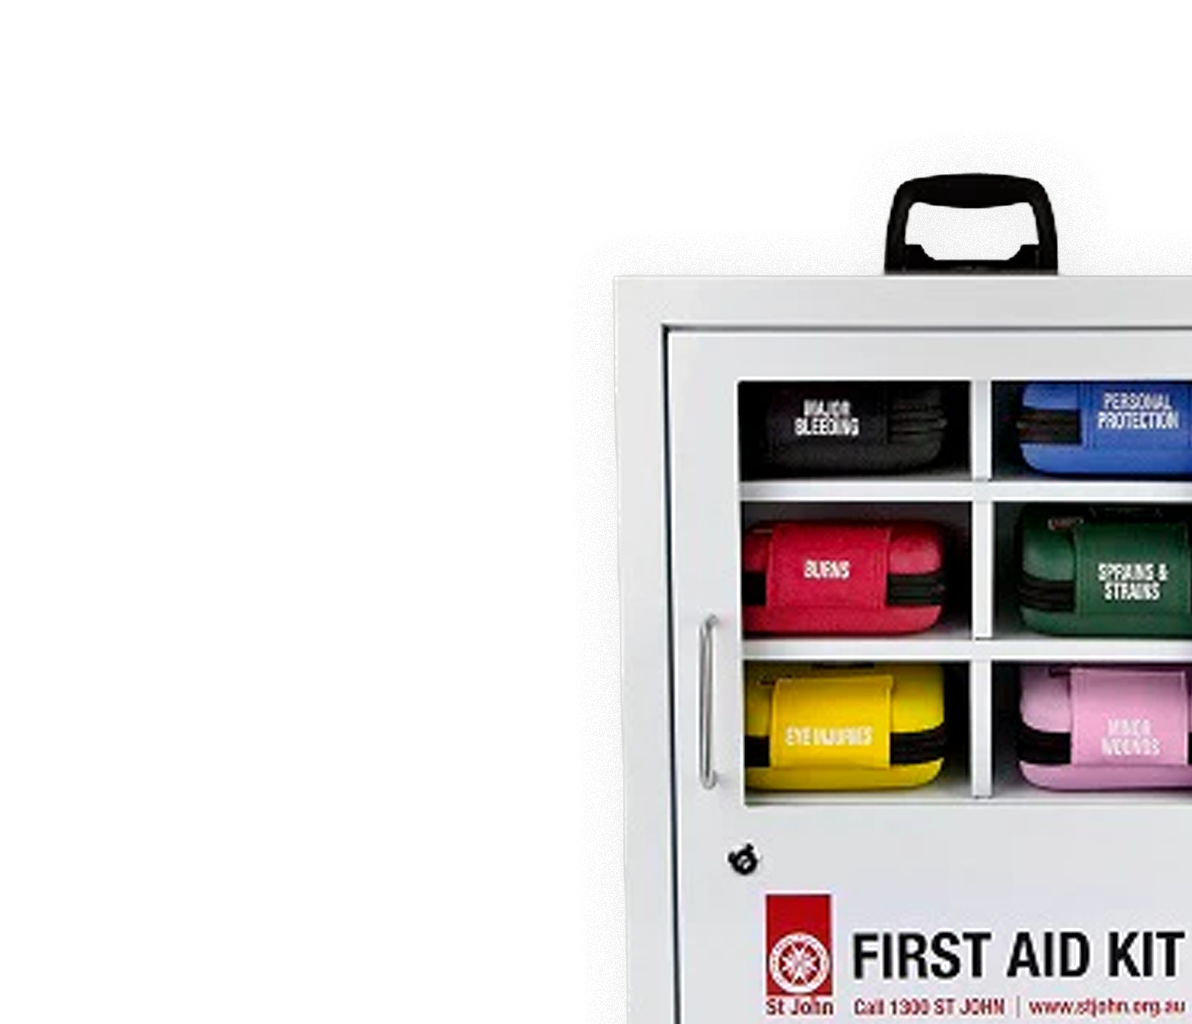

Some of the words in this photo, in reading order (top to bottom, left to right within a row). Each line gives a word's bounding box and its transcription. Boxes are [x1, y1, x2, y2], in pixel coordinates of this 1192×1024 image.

[1103, 392, 1172, 410] PERSONAL
[1097, 411, 1180, 429] PROTECTION
[803, 559, 850, 580] BURNS
[1098, 563, 1154, 581] SPRAINS
[1104, 581, 1160, 600] STRAINS
[785, 726, 811, 746] EYE
[852, 931, 992, 979] FIRST
[1006, 931, 1090, 978] AID
[1108, 931, 1185, 978] KIT
[765, 998, 785, 1016] St
[791, 997, 834, 1016] John
[854, 998, 884, 1016] Call
[890, 998, 929, 1016] 1300
[934, 998, 957, 1016] ST
[960, 998, 1005, 1016] JOHN
[1028, 997, 1186, 1018] www.stjohn.org.au
